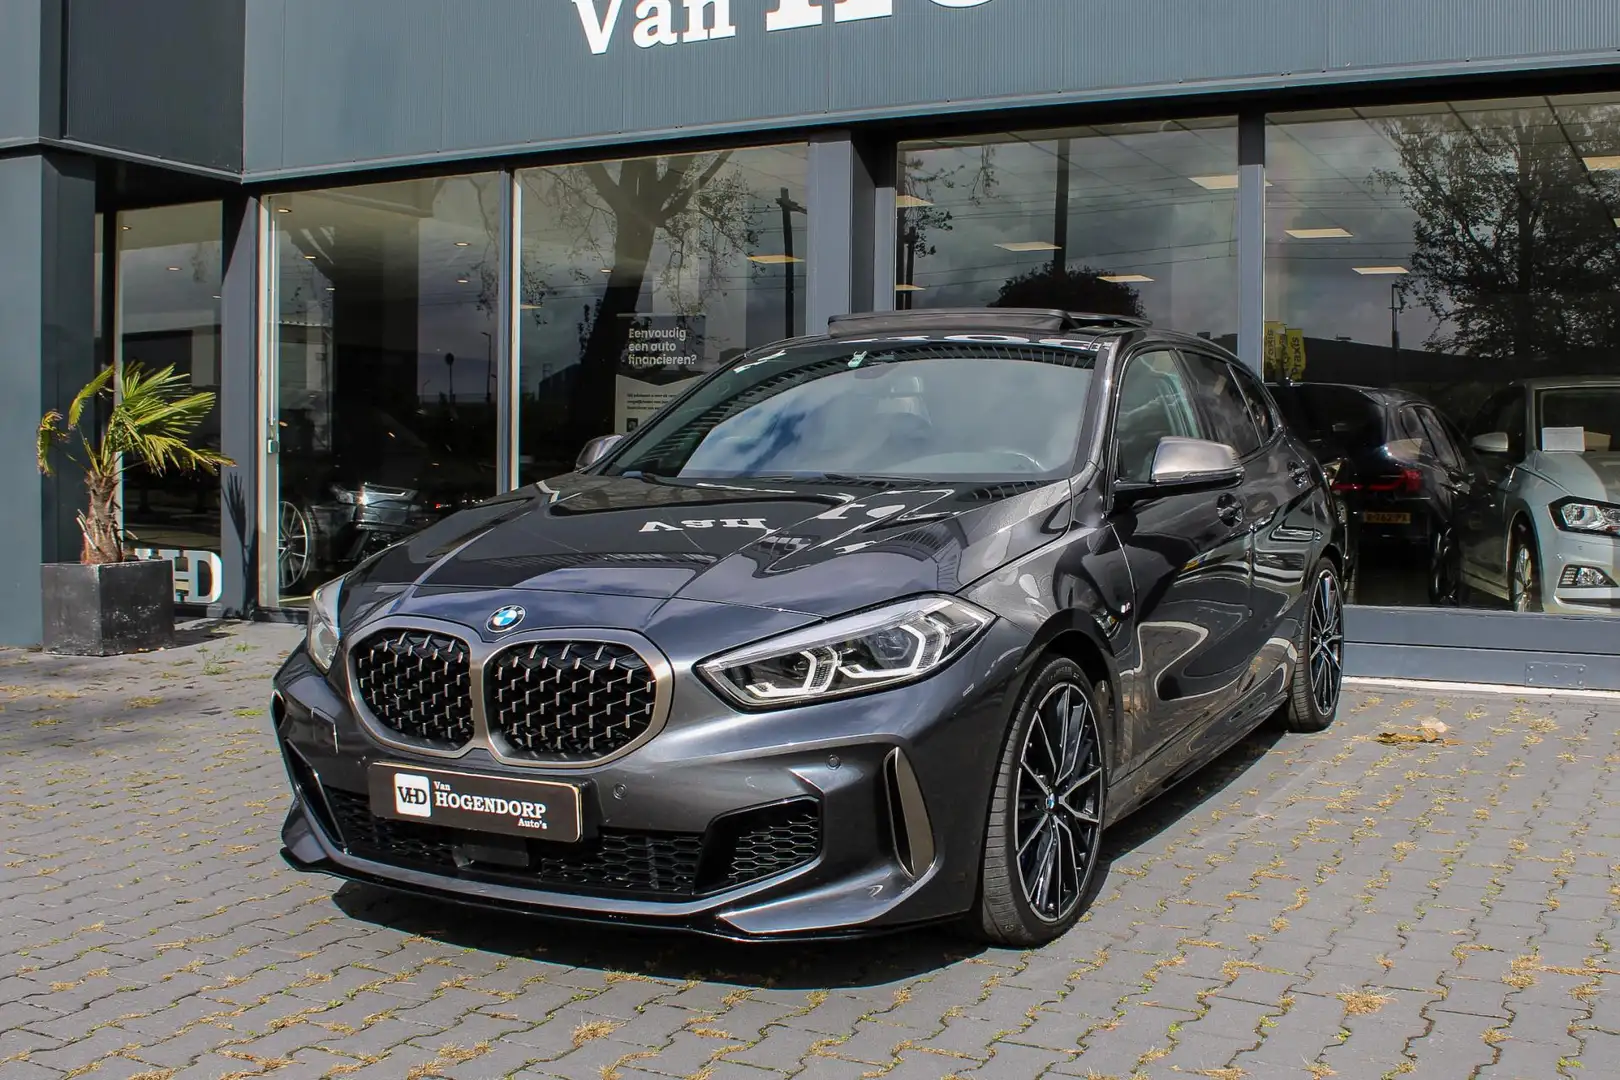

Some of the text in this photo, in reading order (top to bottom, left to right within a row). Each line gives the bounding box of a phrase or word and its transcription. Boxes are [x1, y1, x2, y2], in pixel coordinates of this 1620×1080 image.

[571, 0, 736, 55] Van
[628, 326, 687, 341] Eenvoudig
[628, 341, 677, 352] een auto
[627, 353, 697, 365] financieren?
[135, 548, 223, 603] HD
[433, 780, 451, 791] Van
[396, 786, 427, 805] VHD
[433, 791, 547, 819] HOGENDORP
[517, 818, 548, 830] Auto's
